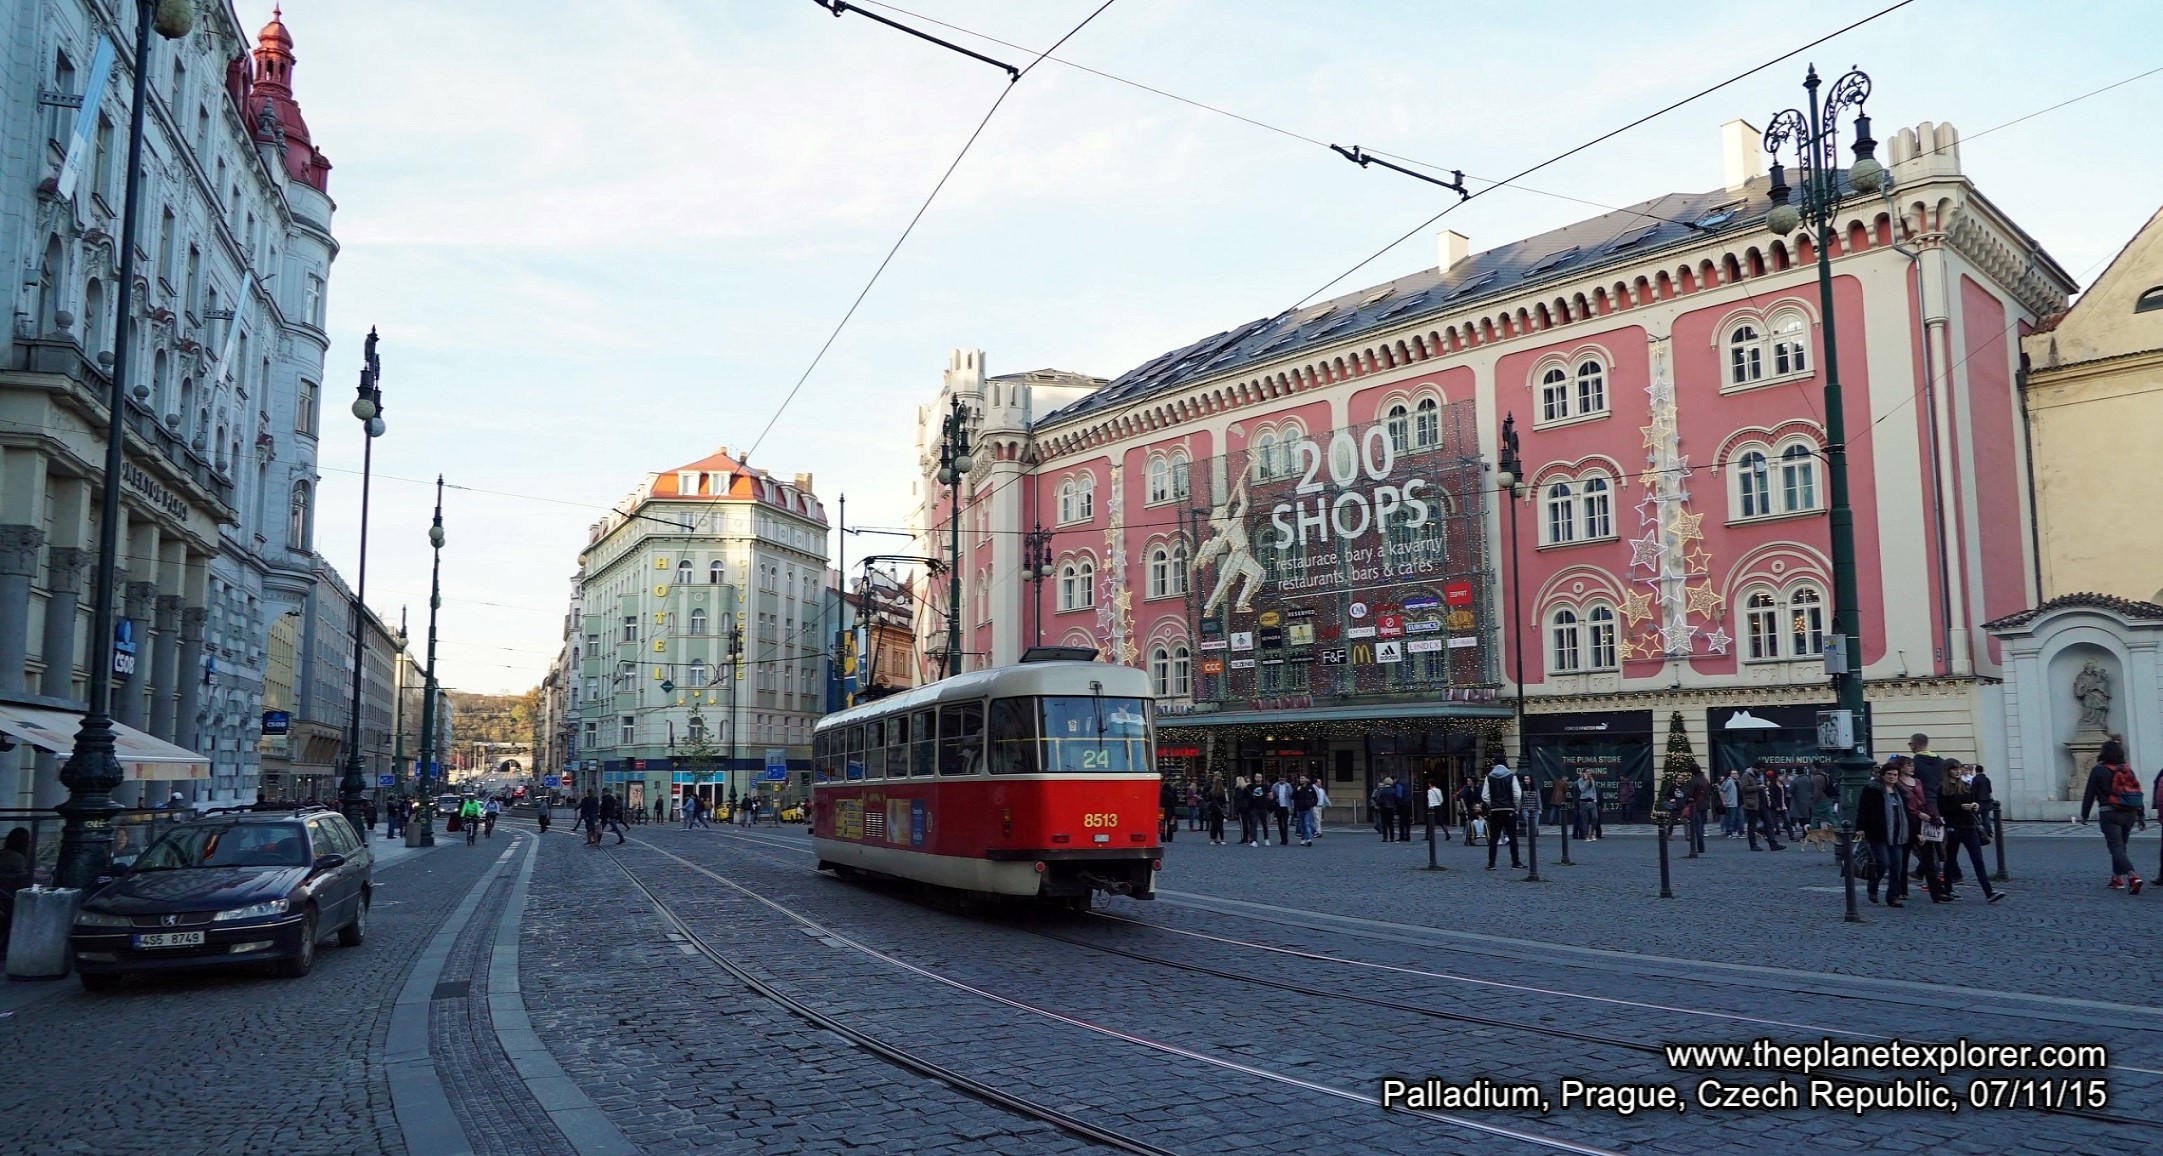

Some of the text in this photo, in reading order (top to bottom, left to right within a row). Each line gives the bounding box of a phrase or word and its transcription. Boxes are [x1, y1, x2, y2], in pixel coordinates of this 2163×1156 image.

[1290, 425, 1394, 495] 200
[1271, 478, 1429, 550] SHOPS
[1276, 550, 1342, 572] restaurace,
[1344, 546, 1373, 564] bary
[1377, 546, 1385, 558] a
[736, 559, 747, 603] CITY
[1278, 568, 1349, 591] restaurants,
[1352, 565, 1378, 582] bars
[1383, 562, 1394, 578] &
[653, 558, 669, 681] HOTEL
[1408, 622, 1438, 631] EURONICS
[1204, 662, 1221, 672] CCC
[1322, 650, 1345, 665] F&F
[1083, 749, 1109, 768] 24
[1598, 755, 1622, 763] STORE
[1083, 813, 1118, 828] 8513
[142, 932, 200, 945] 4S5 8749
